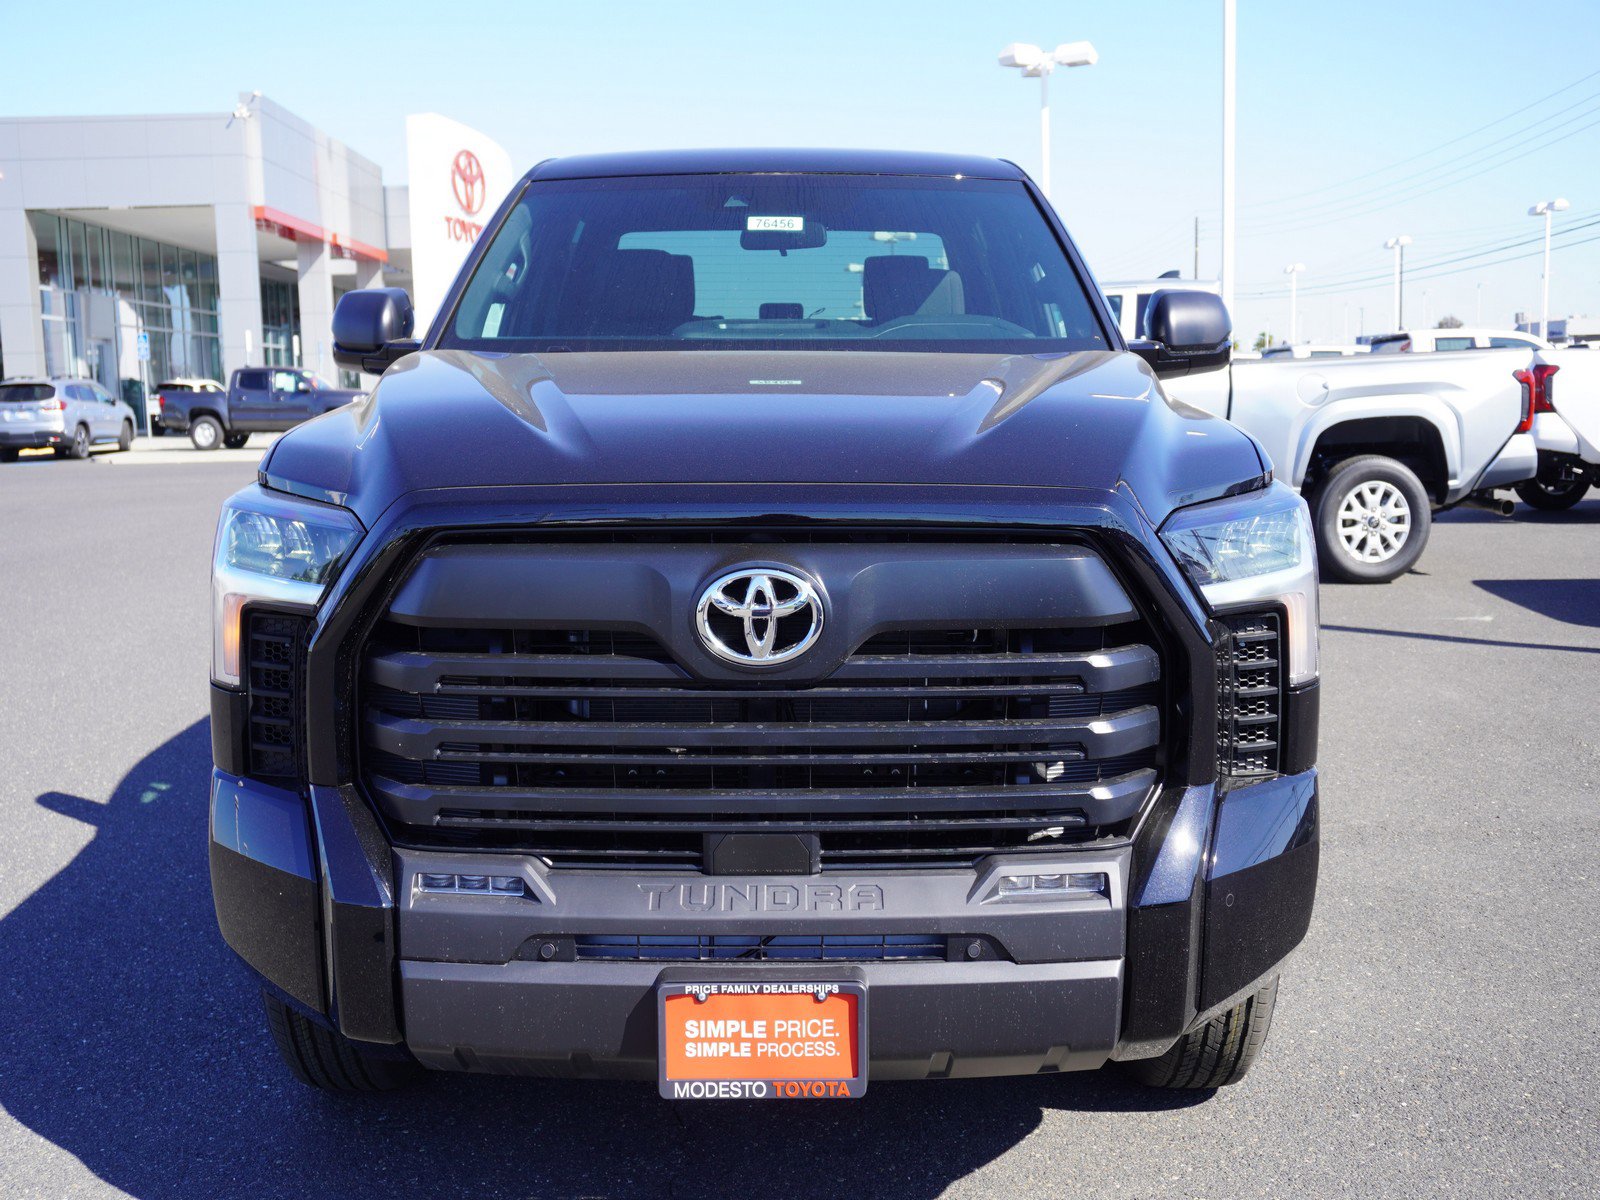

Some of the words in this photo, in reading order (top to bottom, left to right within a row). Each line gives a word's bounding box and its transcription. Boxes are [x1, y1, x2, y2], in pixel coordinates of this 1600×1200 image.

[755, 218, 795, 229] 76456
[636, 883, 885, 912] TUNDRA
[685, 985, 718, 995] PRICE
[721, 984, 760, 994] FAMILY
[763, 984, 840, 994] DEALERSHIPS
[684, 1019, 767, 1039] SIMPLE
[774, 1018, 840, 1038] PRICE.
[684, 1042, 752, 1058] SIMPLE
[757, 1041, 841, 1058] PROCESS.
[674, 1081, 767, 1098] MODESTO
[772, 1081, 851, 1097] TOYOTA
